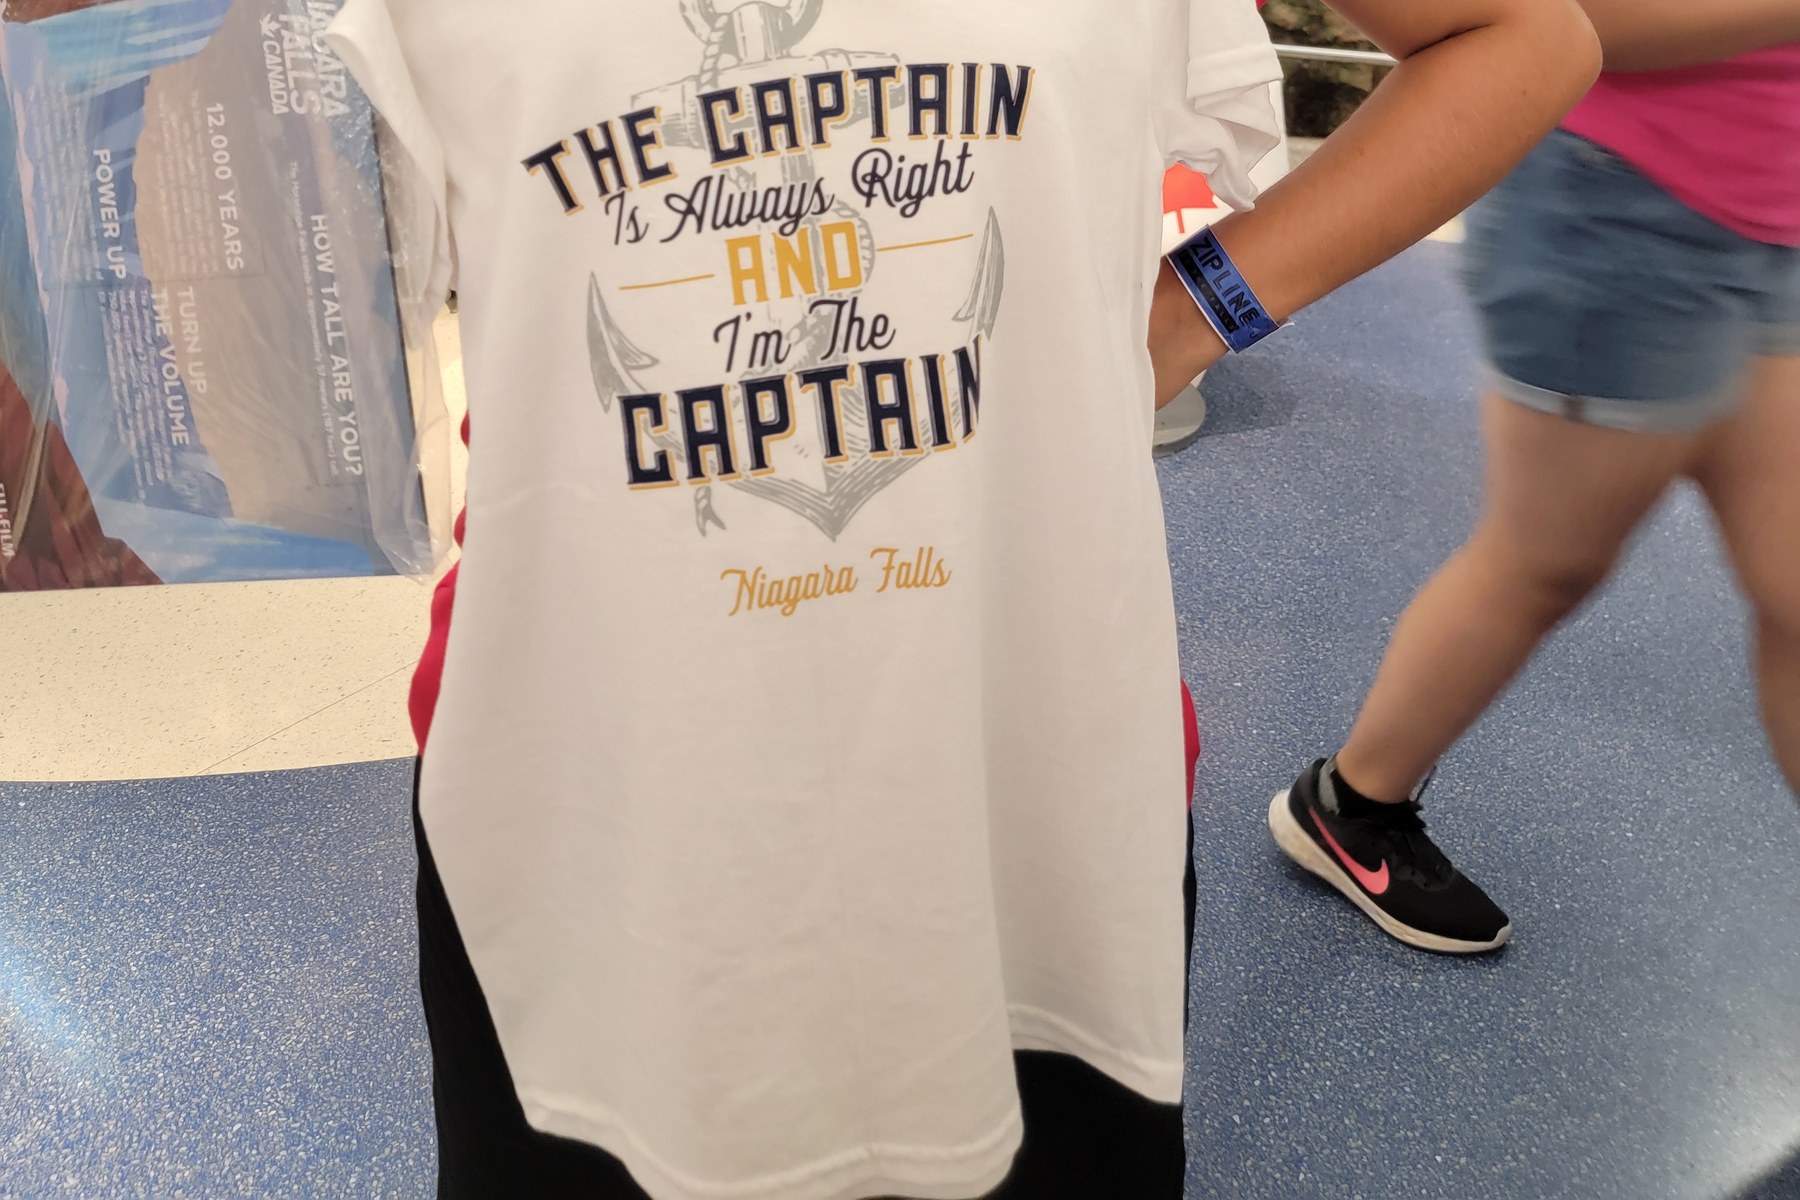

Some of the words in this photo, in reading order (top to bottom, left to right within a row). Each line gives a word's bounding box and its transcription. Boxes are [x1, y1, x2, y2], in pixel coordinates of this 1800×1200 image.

[262, 39, 289, 114] CANADA
[278, 11, 321, 116] FALLS
[520, 105, 678, 216] THE
[696, 63, 1035, 169] CAPTAIN
[92, 148, 121, 238] POWER
[604, 190, 649, 245] Is
[660, 175, 834, 243] Always
[851, 139, 974, 218] Right
[105, 245, 126, 280] UP
[217, 189, 243, 271] YEARS
[309, 213, 334, 274] HOW
[726, 221, 863, 305] AND
[149, 290, 173, 337] THE
[175, 286, 202, 353] TURN
[319, 282, 345, 346] TALL
[713, 312, 791, 373] I'm
[808, 296, 896, 362] The
[157, 343, 189, 447] VOLUME
[186, 360, 207, 395] UP
[328, 352, 353, 402] ARE
[617, 334, 982, 489] CAPTAIN
[337, 411, 363, 477] YOU?
[720, 567, 858, 616] Niagara
[869, 546, 951, 593] Falls
